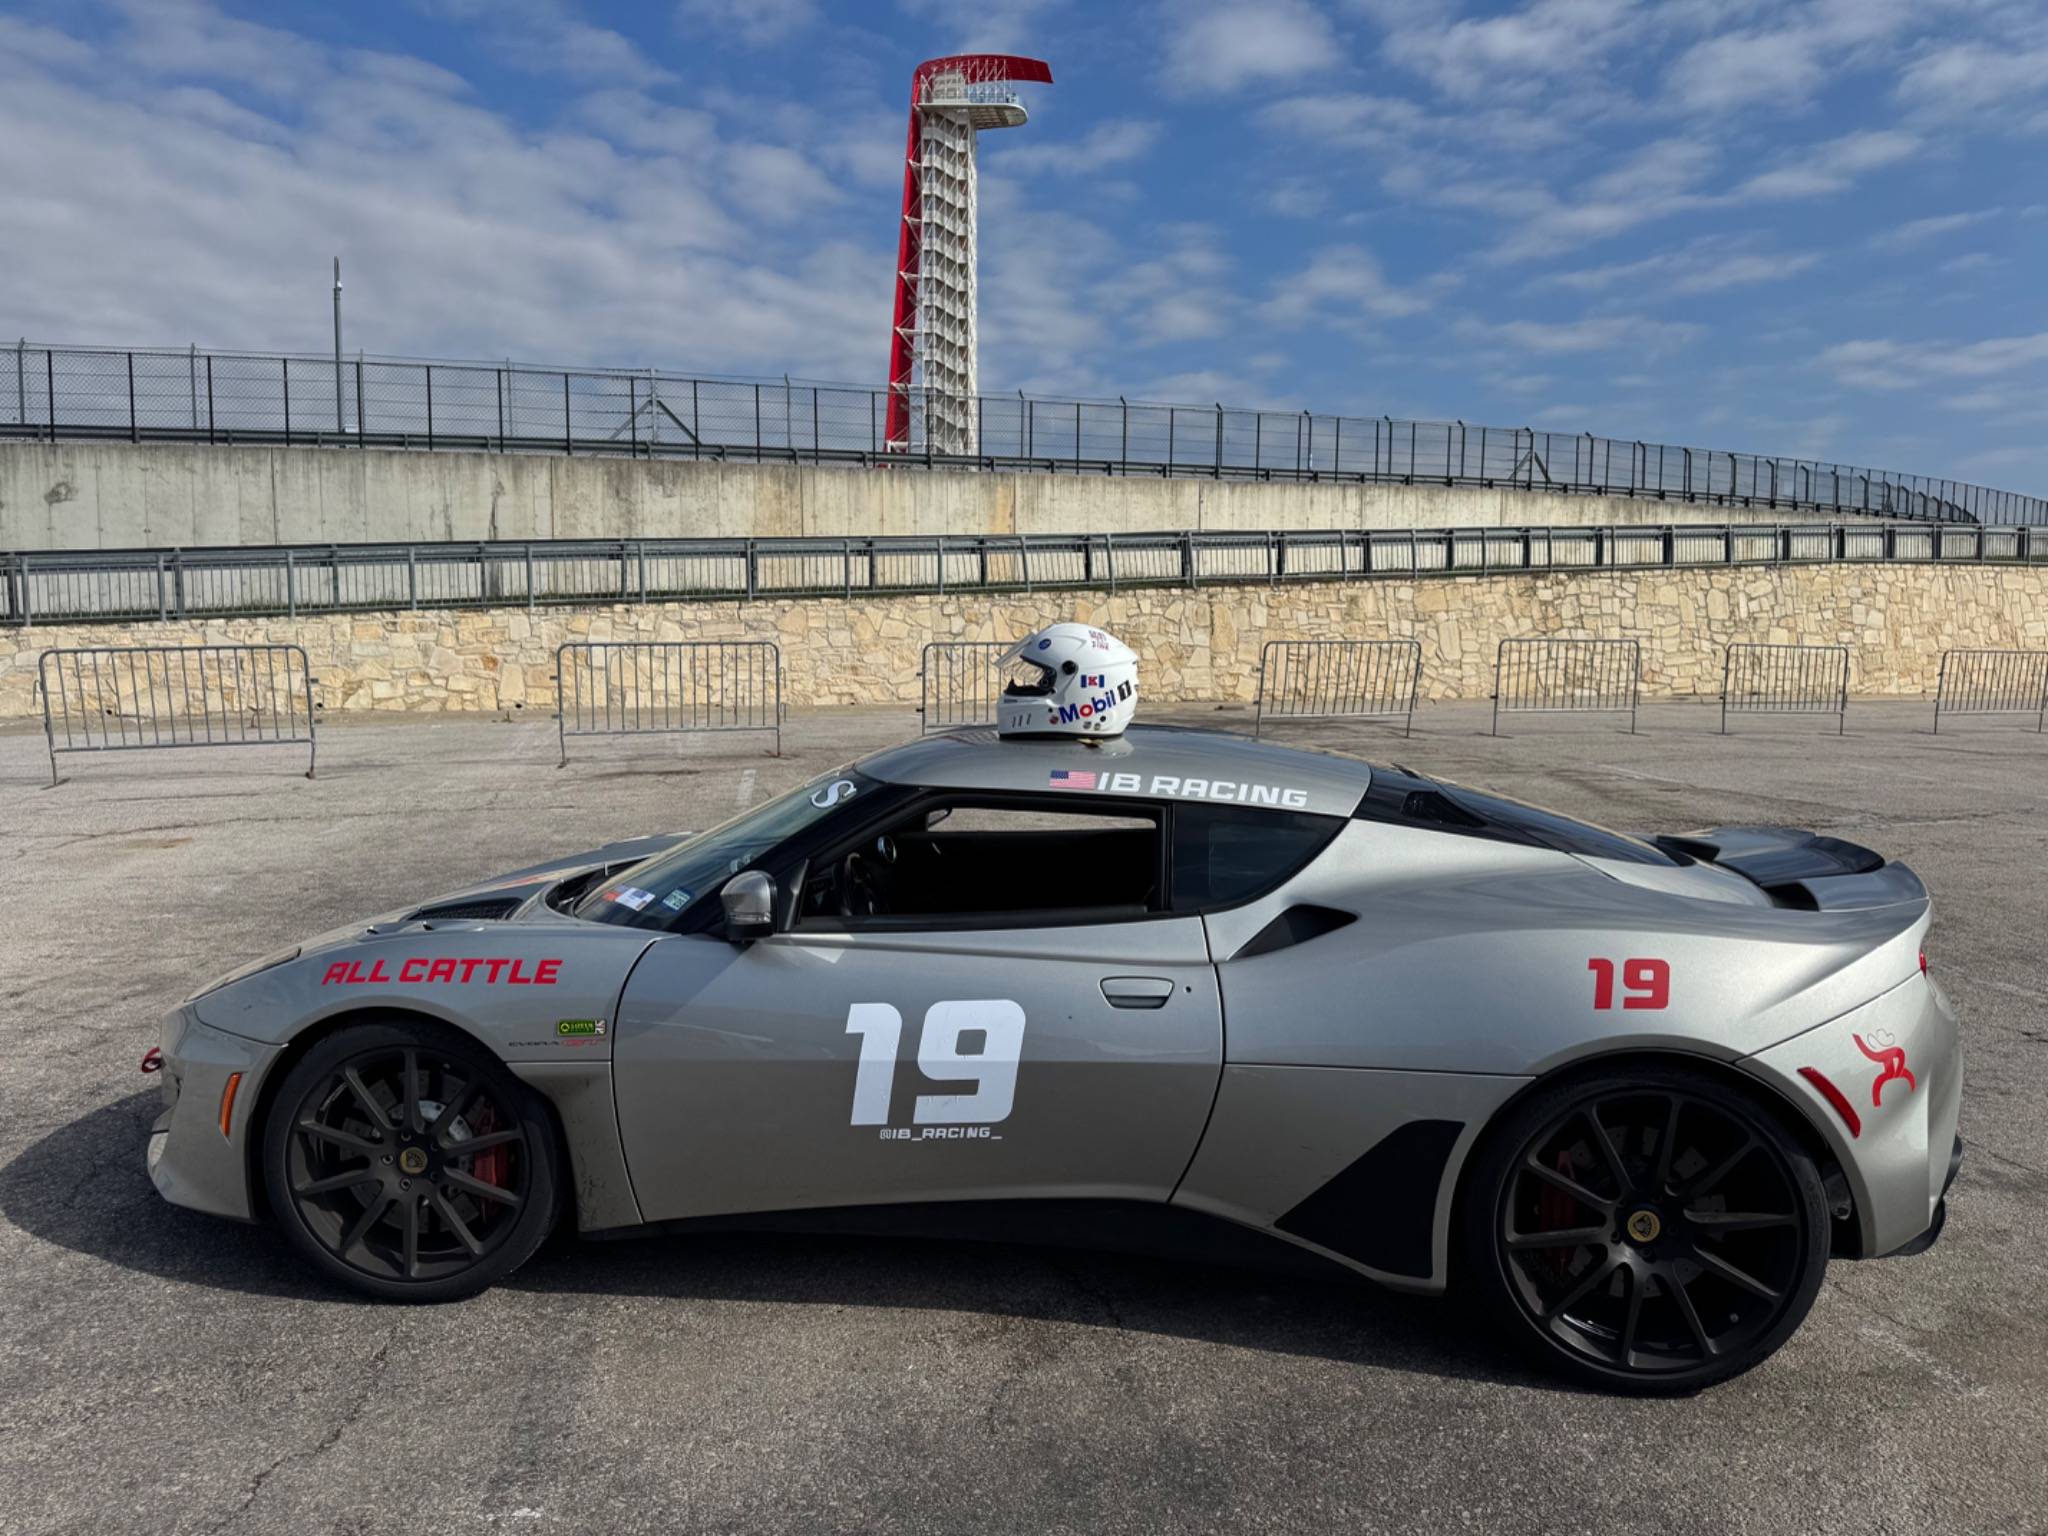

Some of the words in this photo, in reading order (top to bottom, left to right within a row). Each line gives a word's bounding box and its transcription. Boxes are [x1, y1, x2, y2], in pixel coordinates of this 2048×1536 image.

[1058, 689, 1117, 724] Mobil
[1118, 681, 1131, 700] 1
[1098, 772, 1142, 793] IB
[1150, 775, 1308, 807] RACING
[321, 959, 391, 986] ALL
[399, 958, 564, 985] CATTLE
[1588, 958, 1670, 1010] 19
[846, 1000, 1026, 1125] 19
